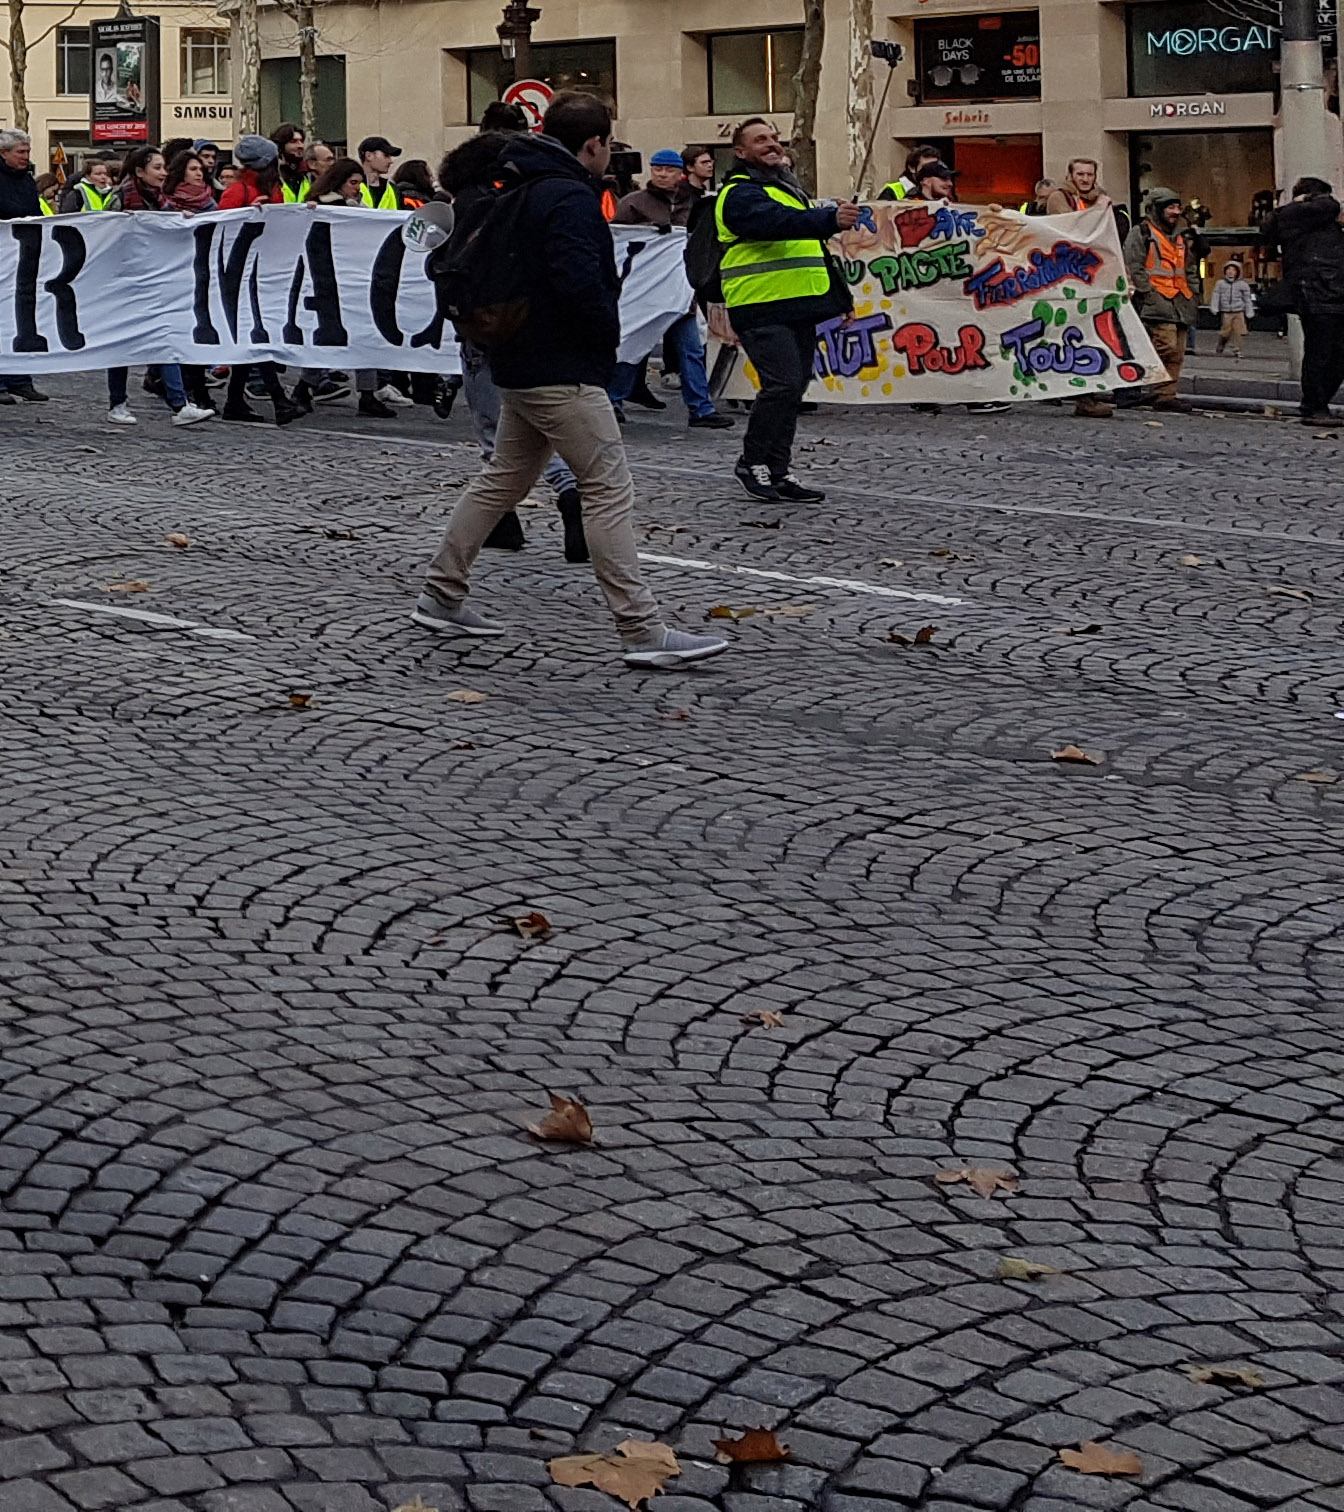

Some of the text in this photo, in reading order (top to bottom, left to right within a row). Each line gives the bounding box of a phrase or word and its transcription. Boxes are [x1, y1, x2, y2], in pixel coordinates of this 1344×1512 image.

[938, 38, 974, 50] BLACK
[942, 50, 970, 61] DAYS
[1150, 101, 1226, 117] MORGAN
[868, 240, 974, 297] PACTE
[892, 322, 992, 375] POUR
